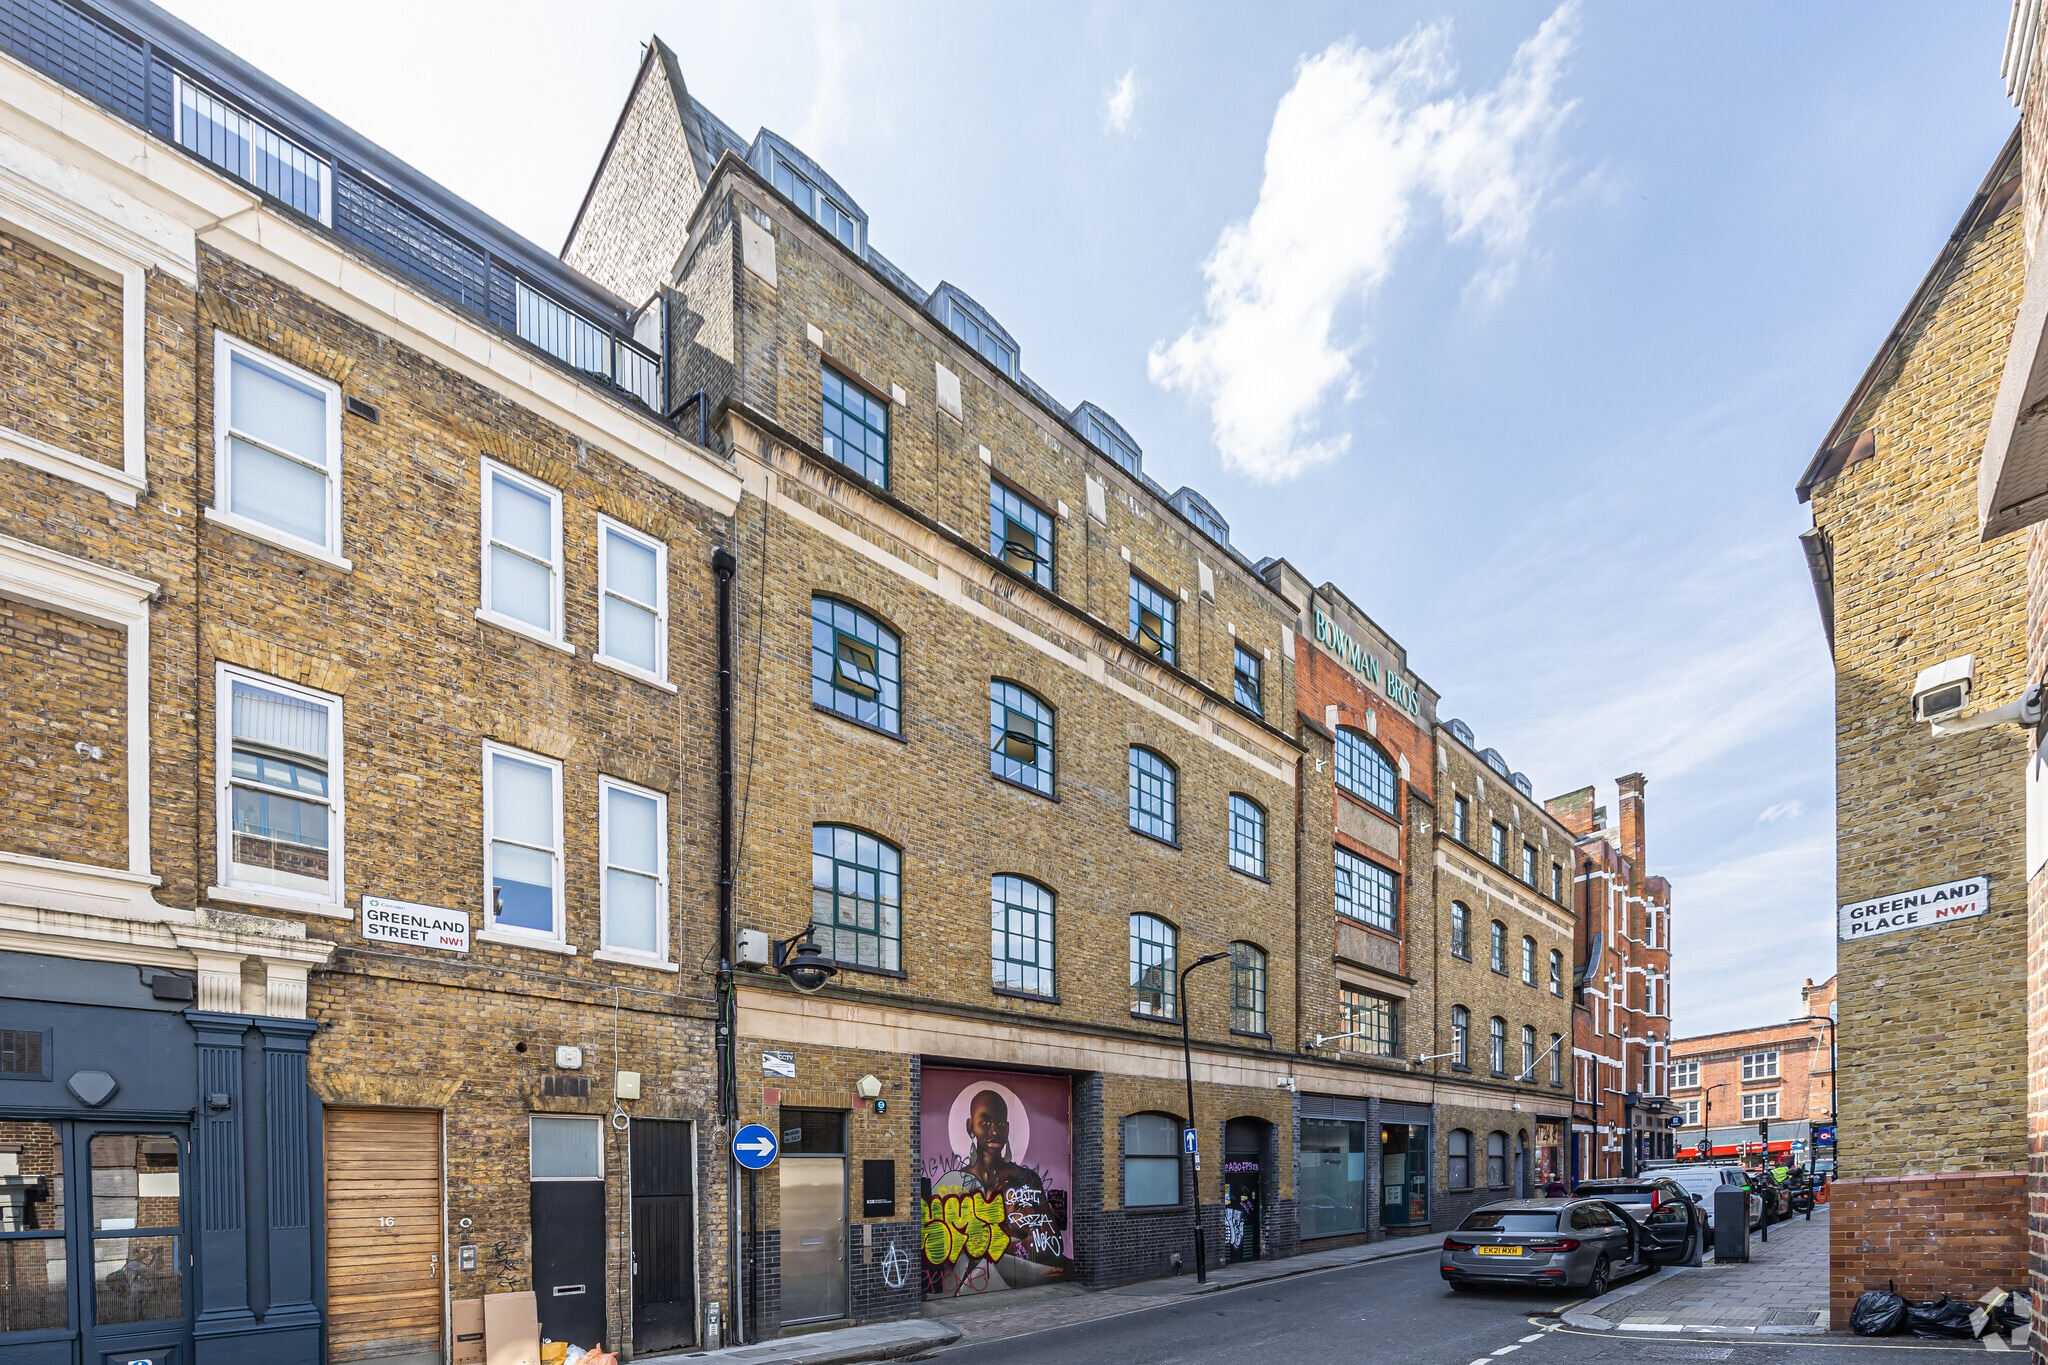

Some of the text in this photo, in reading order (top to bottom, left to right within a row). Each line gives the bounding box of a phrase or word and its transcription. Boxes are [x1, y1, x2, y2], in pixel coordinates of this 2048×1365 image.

[1316, 609, 1418, 716] BOWMAN BROS
[380, 902, 405, 910] Camden
[1850, 883, 1980, 919] GREENLAND
[367, 909, 465, 933] GREENLAND
[1852, 911, 1918, 934] PLACE
[368, 923, 463, 947] STREET NW1
[377, 1216, 395, 1227] 16
[1483, 1246, 1501, 1254] EK21
